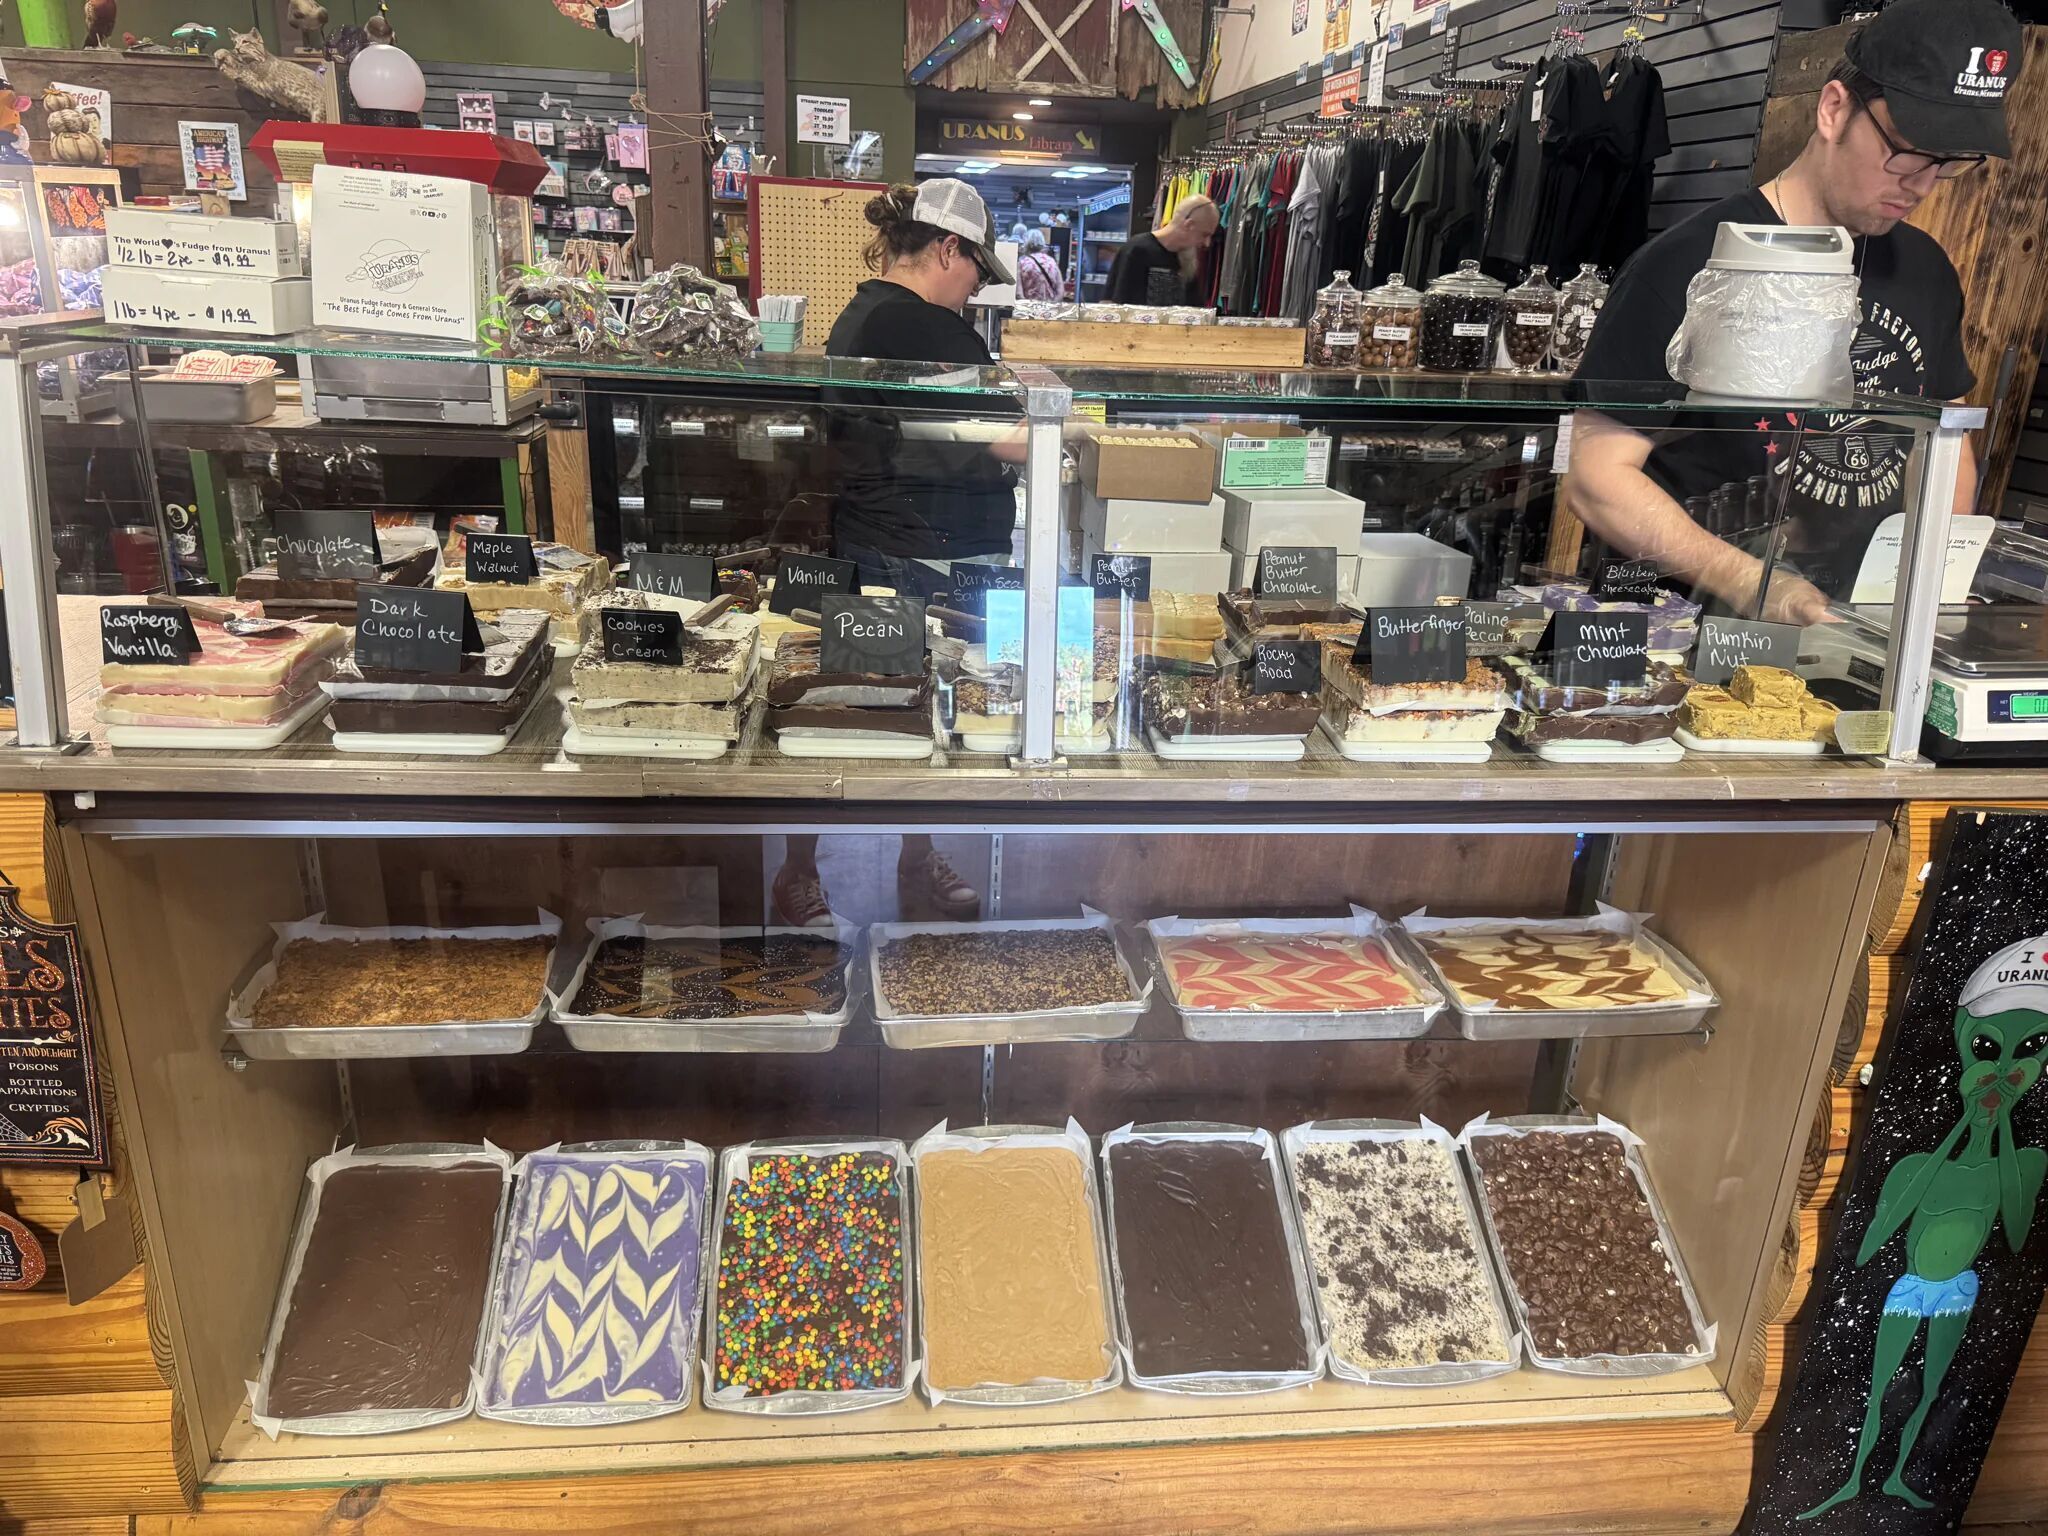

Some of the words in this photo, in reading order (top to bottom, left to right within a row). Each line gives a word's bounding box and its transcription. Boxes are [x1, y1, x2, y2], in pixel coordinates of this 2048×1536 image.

[1965, 47, 1984, 73] I
[1957, 73, 2007, 88] URANUS
[71, 91, 102, 105] fee!
[943, 123, 1025, 141] URANUS
[1029, 136, 1073, 152] Library
[113, 236, 131, 244] The
[134, 238, 160, 246] World
[182, 242, 209, 251] Fudge
[212, 244, 238, 253] from
[236, 246, 271, 256] Uranus!
[118, 245, 135, 263] 1/2
[369, 254, 419, 279] URANUS
[323, 302, 341, 312] "The
[344, 305, 359, 314] Best
[362, 307, 384, 318] Fudge
[386, 309, 410, 319] Comes
[413, 313, 432, 321] From
[434, 314, 465, 324] Uranus"
[340, 297, 360, 305] Uranus
[361, 298, 379, 307] Fudge
[380, 301, 401, 310] Factory
[408, 304, 430, 313] General
[431, 306, 447, 314] Store
[1870, 302, 1925, 372] FACTORY
[1798, 450, 1812, 463] ON
[1815, 462, 1867, 481] HISTORIC
[1870, 457, 1892, 478] ROUTE
[1850, 453, 1867, 466] 66
[276, 534, 354, 554] Chocolate
[473, 541, 513, 557] Maple
[1097, 560, 1138, 573] Peanut
[1263, 550, 1305, 566] Peanut
[788, 566, 838, 584] Vanilla
[956, 570, 992, 587] Dark
[1096, 573, 1141, 587] Butter
[1266, 566, 1308, 580] Butter
[1263, 581, 1321, 594] Chocolate
[369, 598, 428, 618] Dark
[102, 608, 182, 637] Raspberry
[362, 618, 462, 644] Chocolate
[607, 617, 665, 633] Cookies
[1378, 614, 1464, 638] Butterfinger
[1580, 621, 1630, 642] Mint
[1703, 623, 1771, 650] Pumkin
[104, 636, 177, 658] Vanilla
[612, 643, 667, 658] Cream
[1257, 644, 1295, 666] Rocky
[1577, 643, 1648, 662] Chocolate
[1710, 648, 1750, 668] Nut
[1257, 662, 1293, 679] Road
[2021, 951, 2035, 963] I
[21, 1047, 41, 1057] AND
[41, 1048, 78, 1058] DELIGHT
[8, 1062, 59, 1071] POISONS
[9, 1078, 63, 1087] BOTTLED
[0, 1087, 77, 1096] APPARITIONS
[8, 1103, 70, 1113] CRYPTIDS
